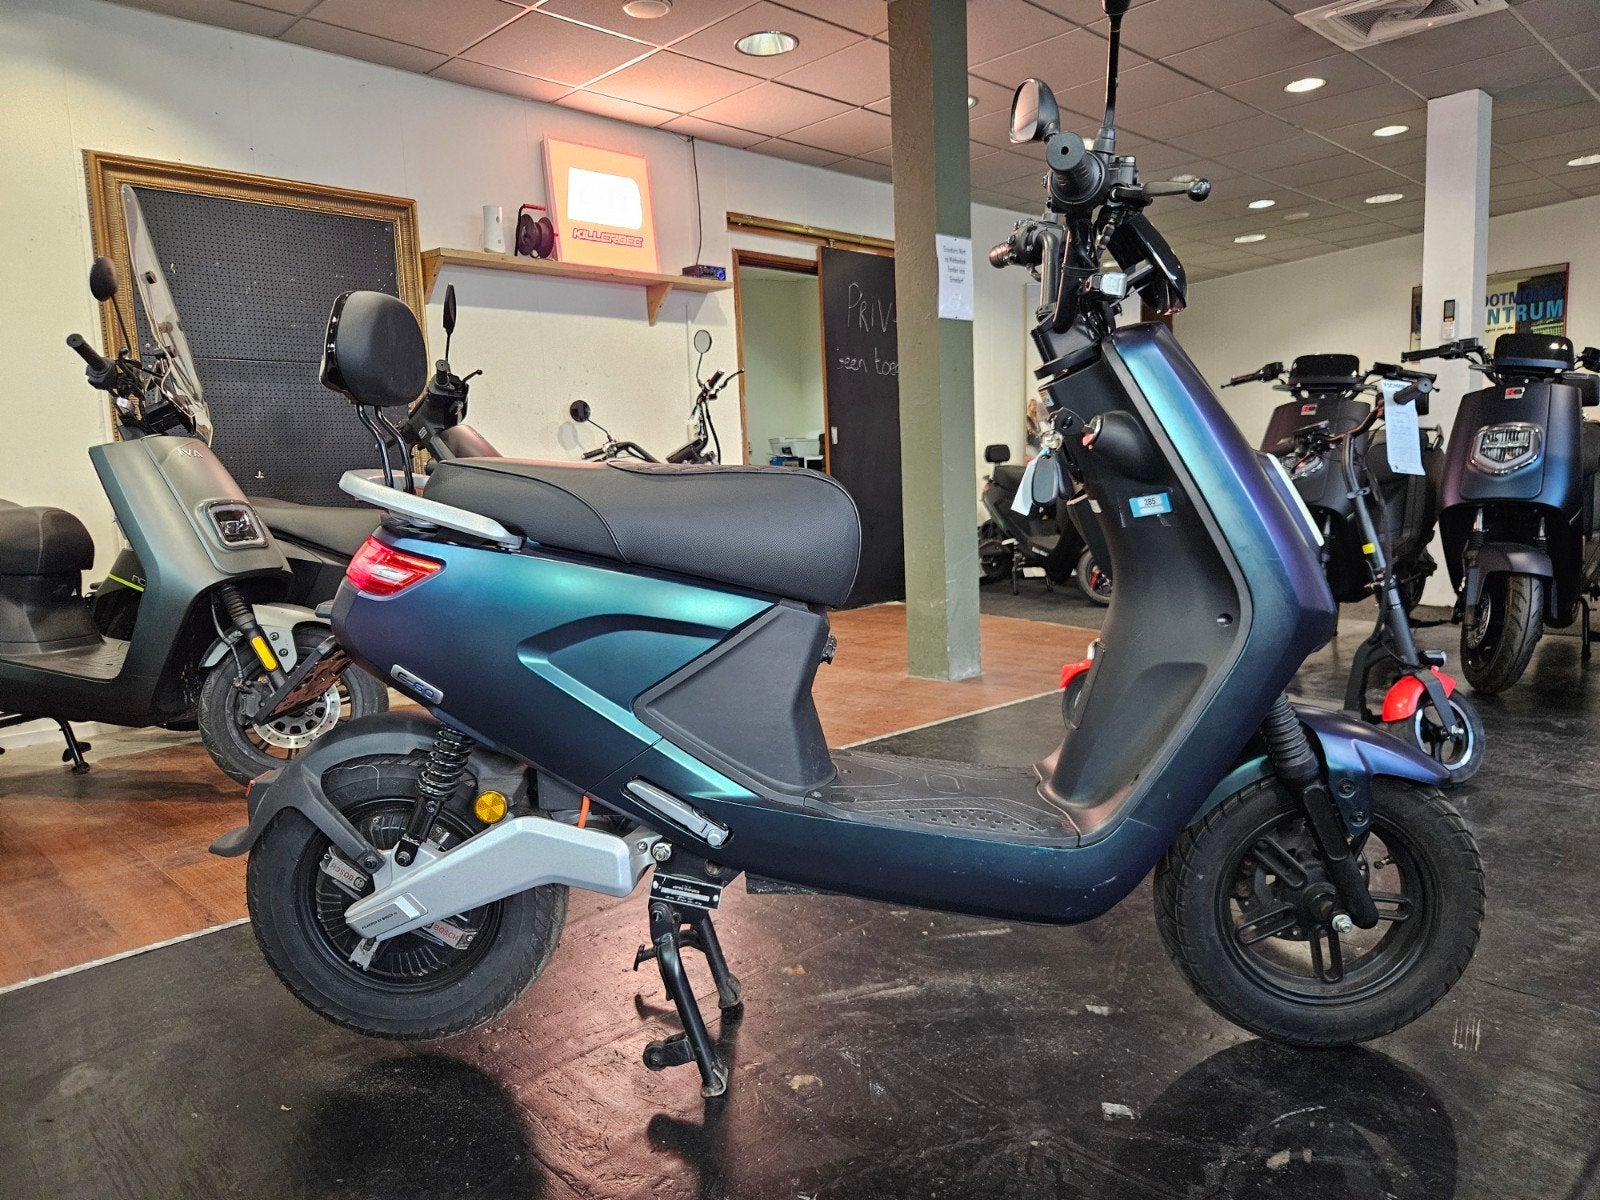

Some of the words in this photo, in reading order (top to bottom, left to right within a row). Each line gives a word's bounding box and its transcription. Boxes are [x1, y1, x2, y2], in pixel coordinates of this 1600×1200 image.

[847, 282, 897, 333] PRIV
[1486, 299, 1564, 325] NTRUM
[874, 346, 899, 376] toe
[433, 924, 460, 941] BOSCH
